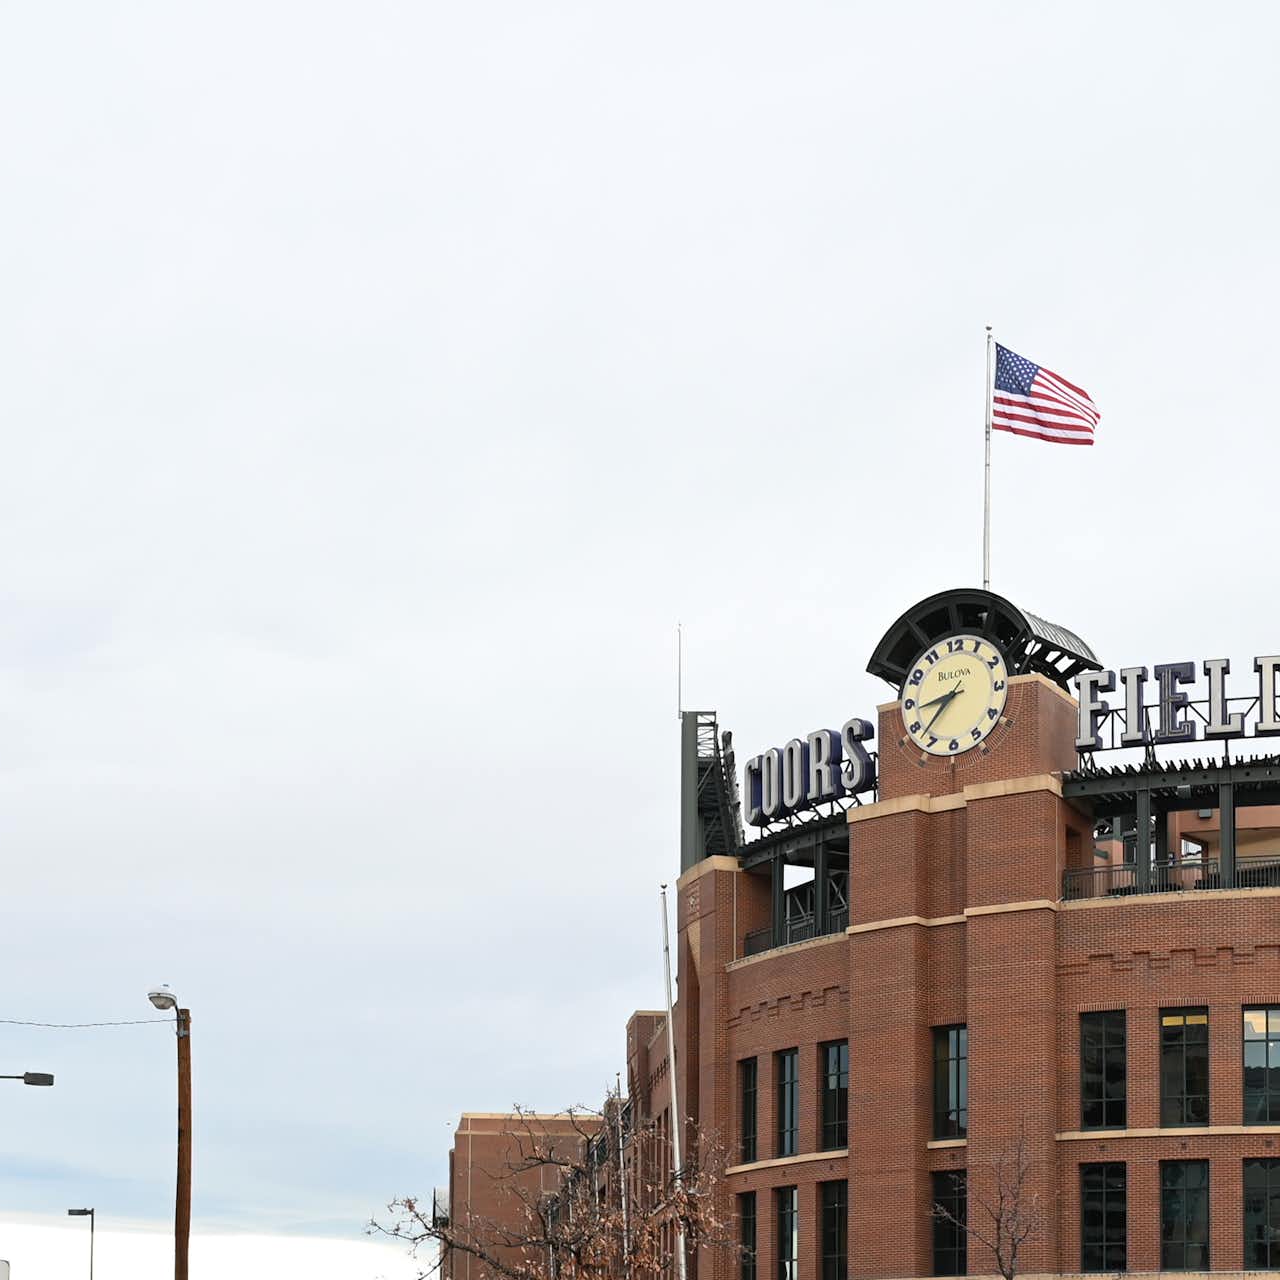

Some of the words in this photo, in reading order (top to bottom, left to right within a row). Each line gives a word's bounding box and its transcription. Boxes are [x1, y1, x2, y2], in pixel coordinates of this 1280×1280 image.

[946, 639, 964, 653] 12
[972, 641, 981, 653] 1
[925, 649, 940, 665] 11
[987, 655, 999, 669] 2
[909, 668, 924, 687] 10
[937, 667, 971, 682] BULOVA
[994, 680, 1004, 692] 3
[904, 698, 915, 710] 9
[986, 707, 998, 721] 4
[909, 721, 921, 734] 8
[970, 727, 982, 741] 5
[926, 736, 938, 749] 7
[949, 738, 960, 751] 6
[744, 717, 875, 827] COORS
